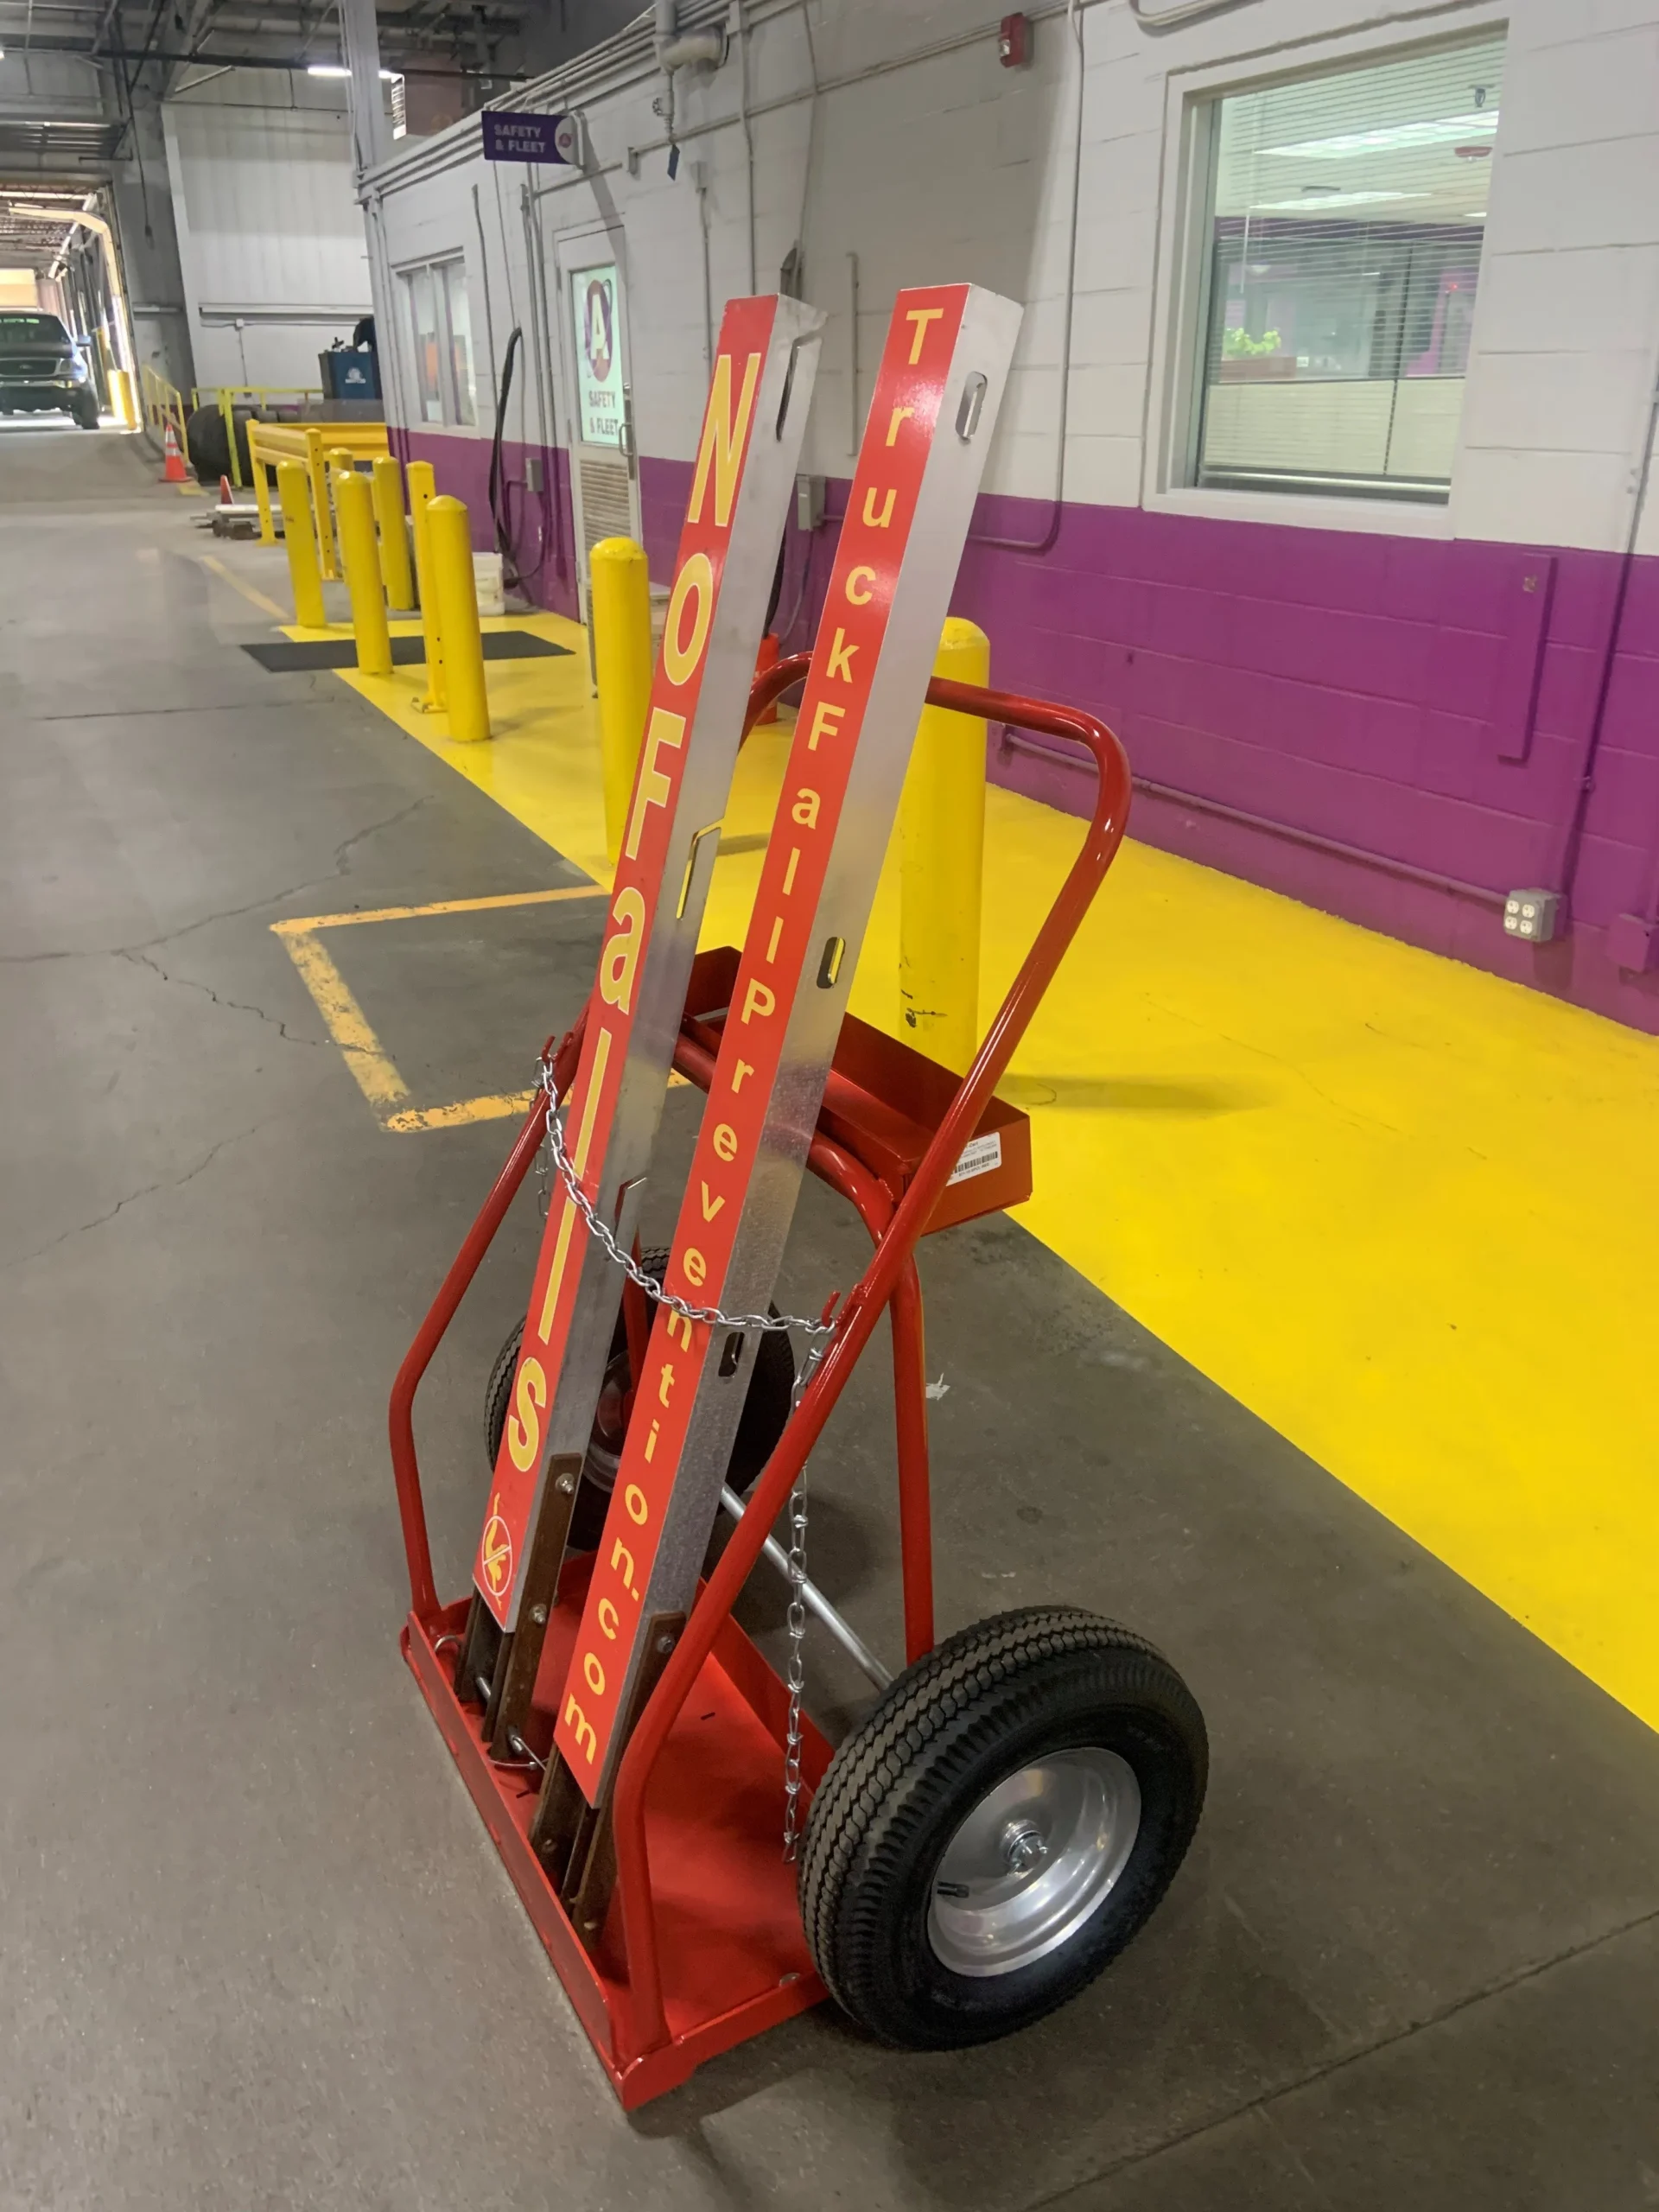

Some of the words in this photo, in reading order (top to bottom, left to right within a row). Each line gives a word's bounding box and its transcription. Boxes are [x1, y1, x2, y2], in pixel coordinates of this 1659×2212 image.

[493, 124, 542, 137] SAFETY
[495, 139, 505, 151] &
[508, 140, 546, 152] FLEET
[590, 294, 610, 360] A
[588, 391, 616, 409] SAFETY
[596, 418, 620, 436] FLEET
